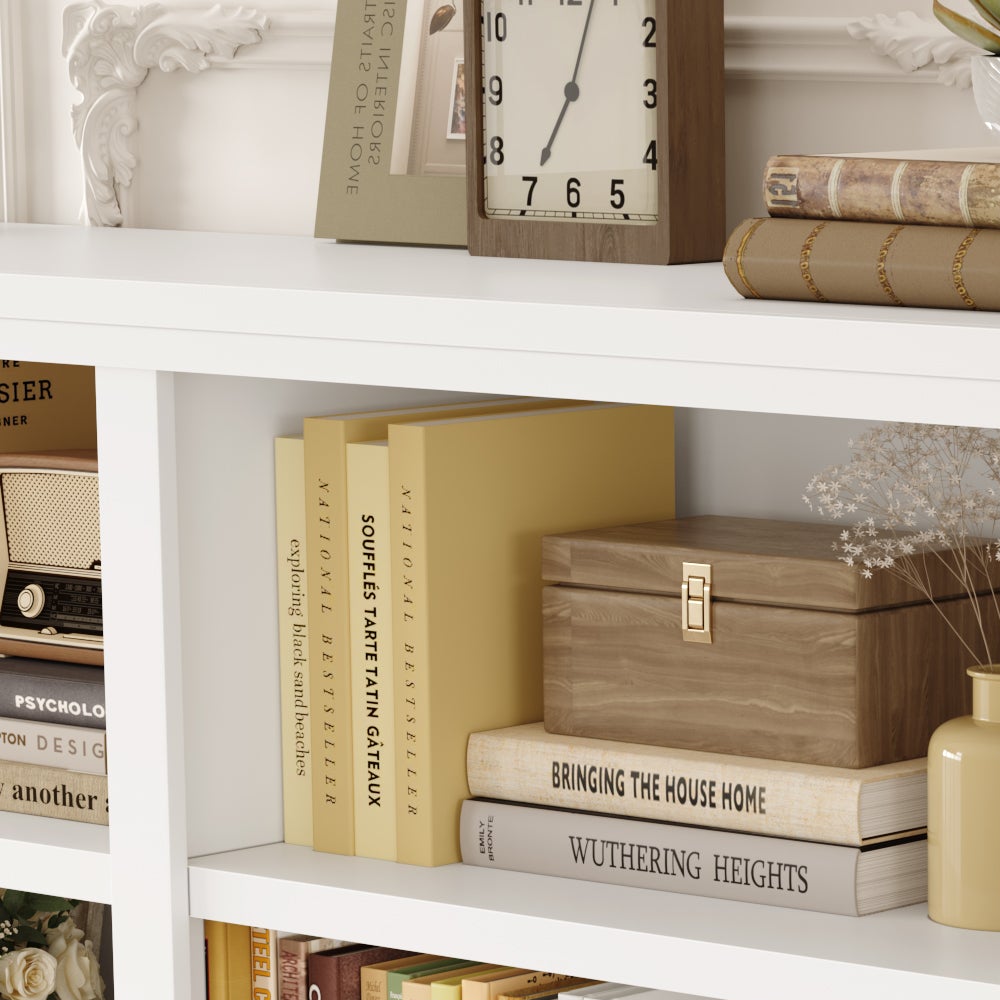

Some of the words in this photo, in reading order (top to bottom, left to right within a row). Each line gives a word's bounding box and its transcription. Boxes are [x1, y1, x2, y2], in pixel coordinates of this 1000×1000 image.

[486, 12, 507, 42] 10
[642, 17, 656, 48] 2
[488, 76, 503, 106] 9
[643, 78, 657, 109] 3
[490, 136, 504, 166] 8
[642, 140, 658, 170] 4
[522, 176, 538, 206] 7
[566, 178, 581, 208] 6
[610, 180, 625, 209] 5
[318, 478, 333, 614] NATIONAL
[361, 514, 380, 600] SOUFFLÉS
[401, 485, 414, 622] NATIONAL
[287, 538, 306, 617] exploring
[293, 623, 307, 666] black
[364, 607, 378, 661] TARTE
[15, 694, 105, 719] PSYCHOLO
[294, 671, 308, 709] sand
[365, 666, 379, 718] TATIN
[321, 633, 337, 805] BESTSELLER
[404, 643, 417, 815] BESTSELLER
[36, 734, 104, 759] DESIG
[294, 711, 310, 777] beaches
[366, 725, 384, 807] GÂTEAUX
[12, 783, 98, 811] another
[552, 761, 625, 797] BRINGING
[630, 771, 660, 801] THE
[665, 776, 716, 808] HOUSE
[721, 782, 766, 815] HOME
[487, 815, 495, 862] BRONTE
[568, 835, 702, 880] WUTHERING
[713, 854, 808, 894] HEIGHTS
[251, 926, 271, 982] TEEL
